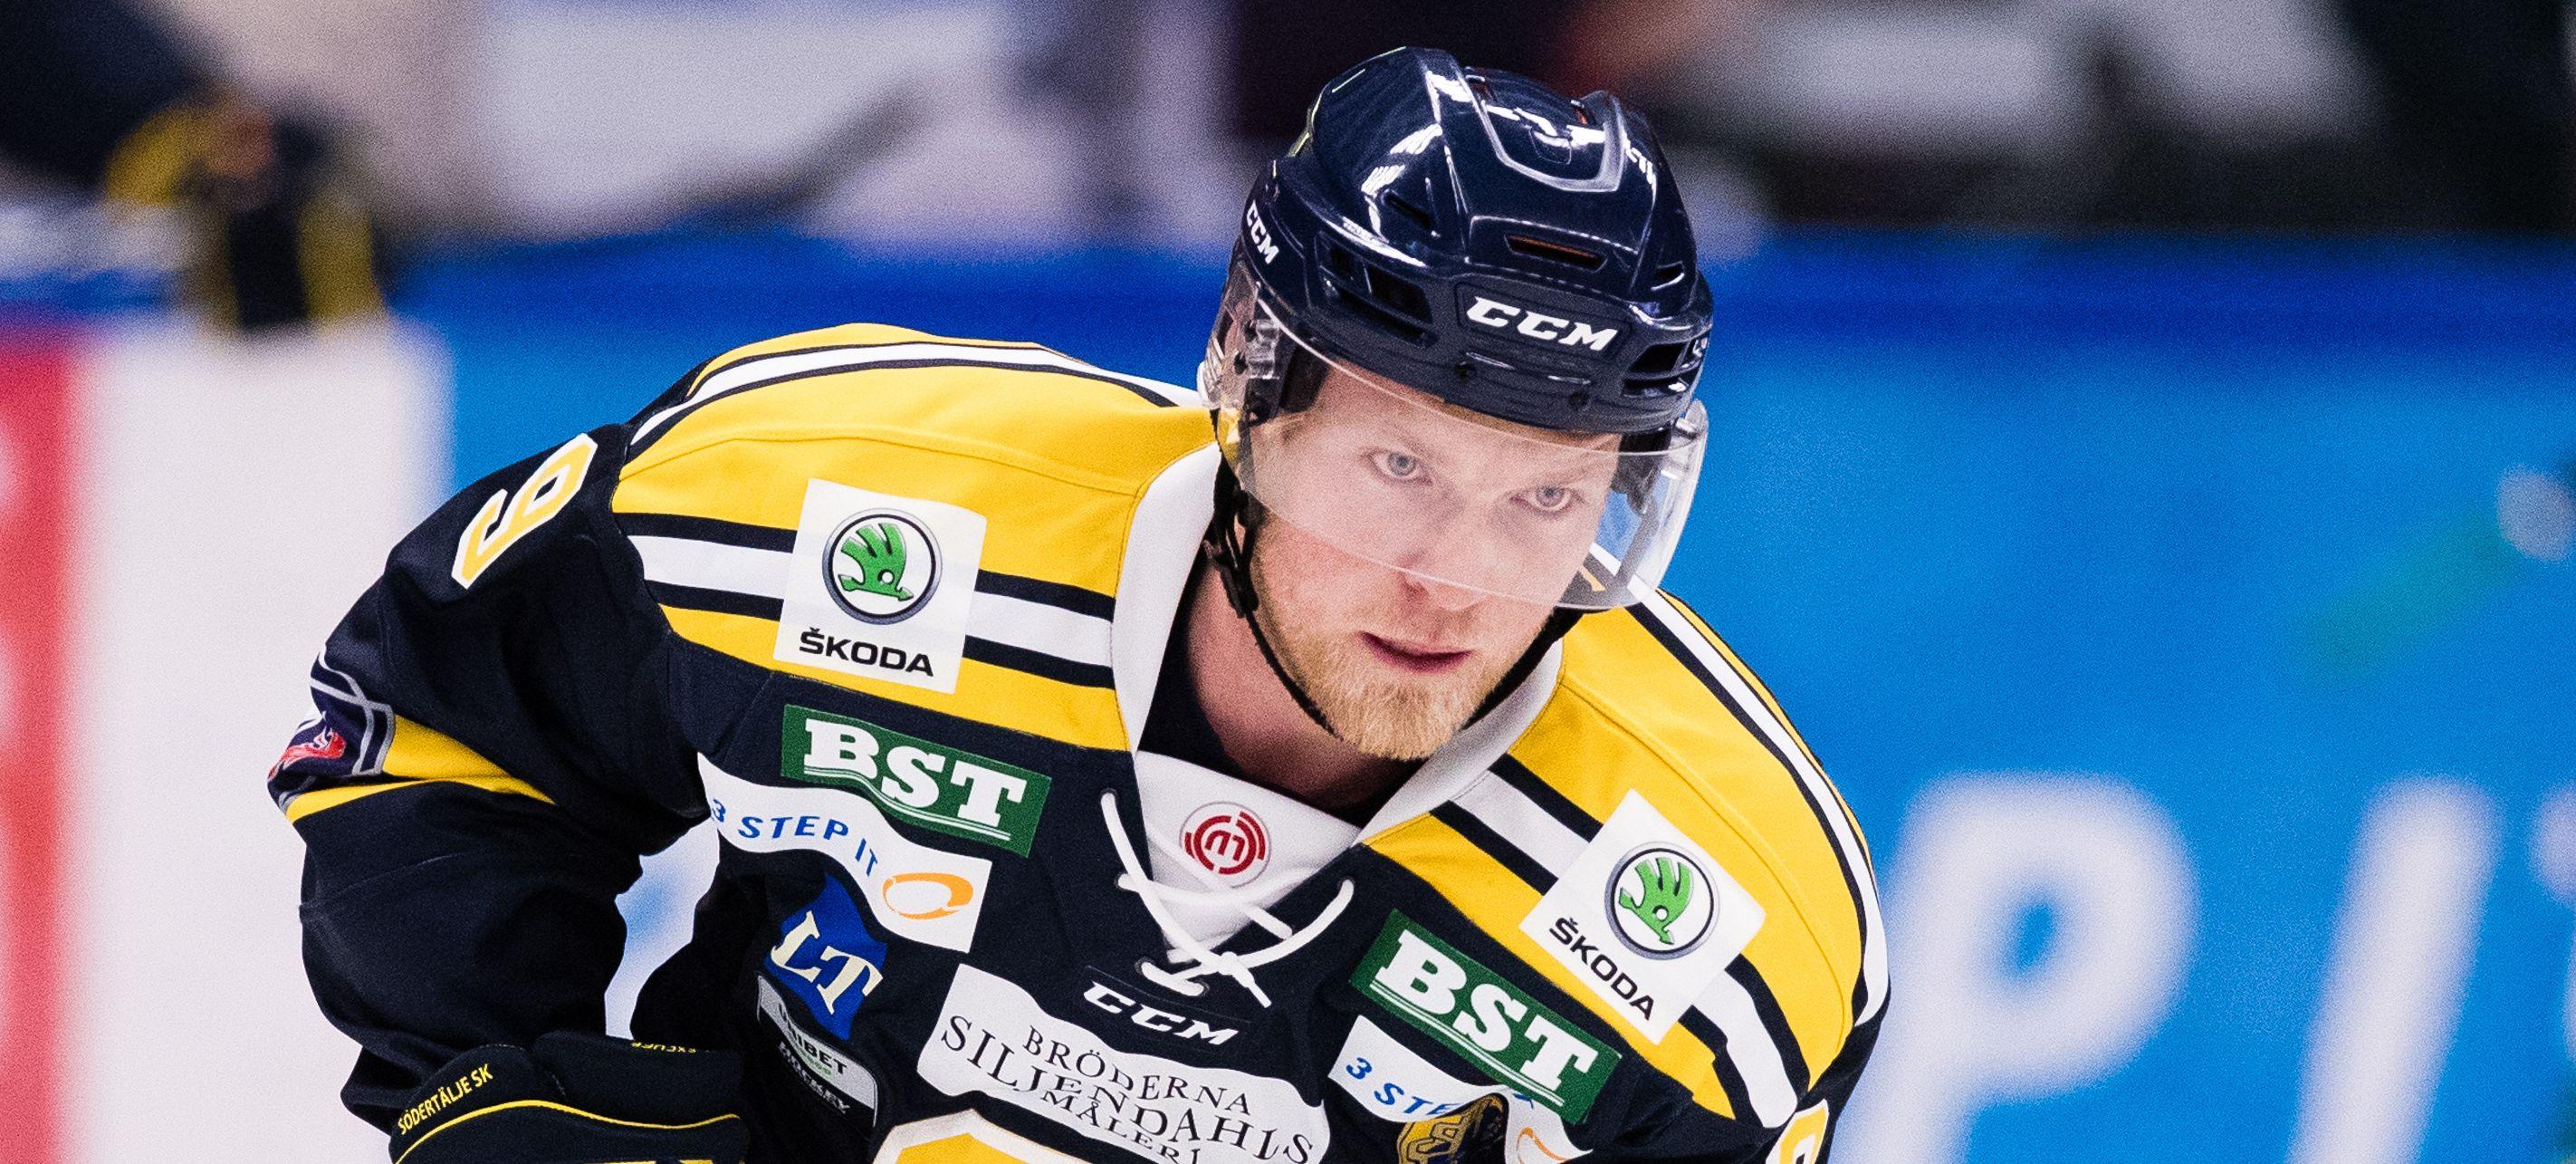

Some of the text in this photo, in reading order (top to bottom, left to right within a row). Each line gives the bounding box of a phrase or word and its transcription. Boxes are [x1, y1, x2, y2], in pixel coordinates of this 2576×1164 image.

[1246, 198, 1279, 265] CCM
[1466, 295, 1619, 351] CCM
[451, 432, 599, 590] 9
[799, 627, 934, 677] ŠKODA
[803, 717, 1028, 828] BST
[737, 815, 849, 841] STEP
[854, 838, 878, 877] IT
[770, 909, 884, 1015] LT
[1549, 917, 1654, 1021] ŠKODA
[1083, 980, 1240, 1046] CCM
[1374, 928, 1599, 1092] BST
[397, 1063, 493, 1135] SÖDERTÄLJE SK
[940, 1015, 1314, 1164] SILJENDAHLS
[1021, 1025, 1251, 1116] BRÖDERNA
[1345, 1057, 1462, 1116] 3 STE
[1040, 1090, 1200, 1164] MÅLERI
